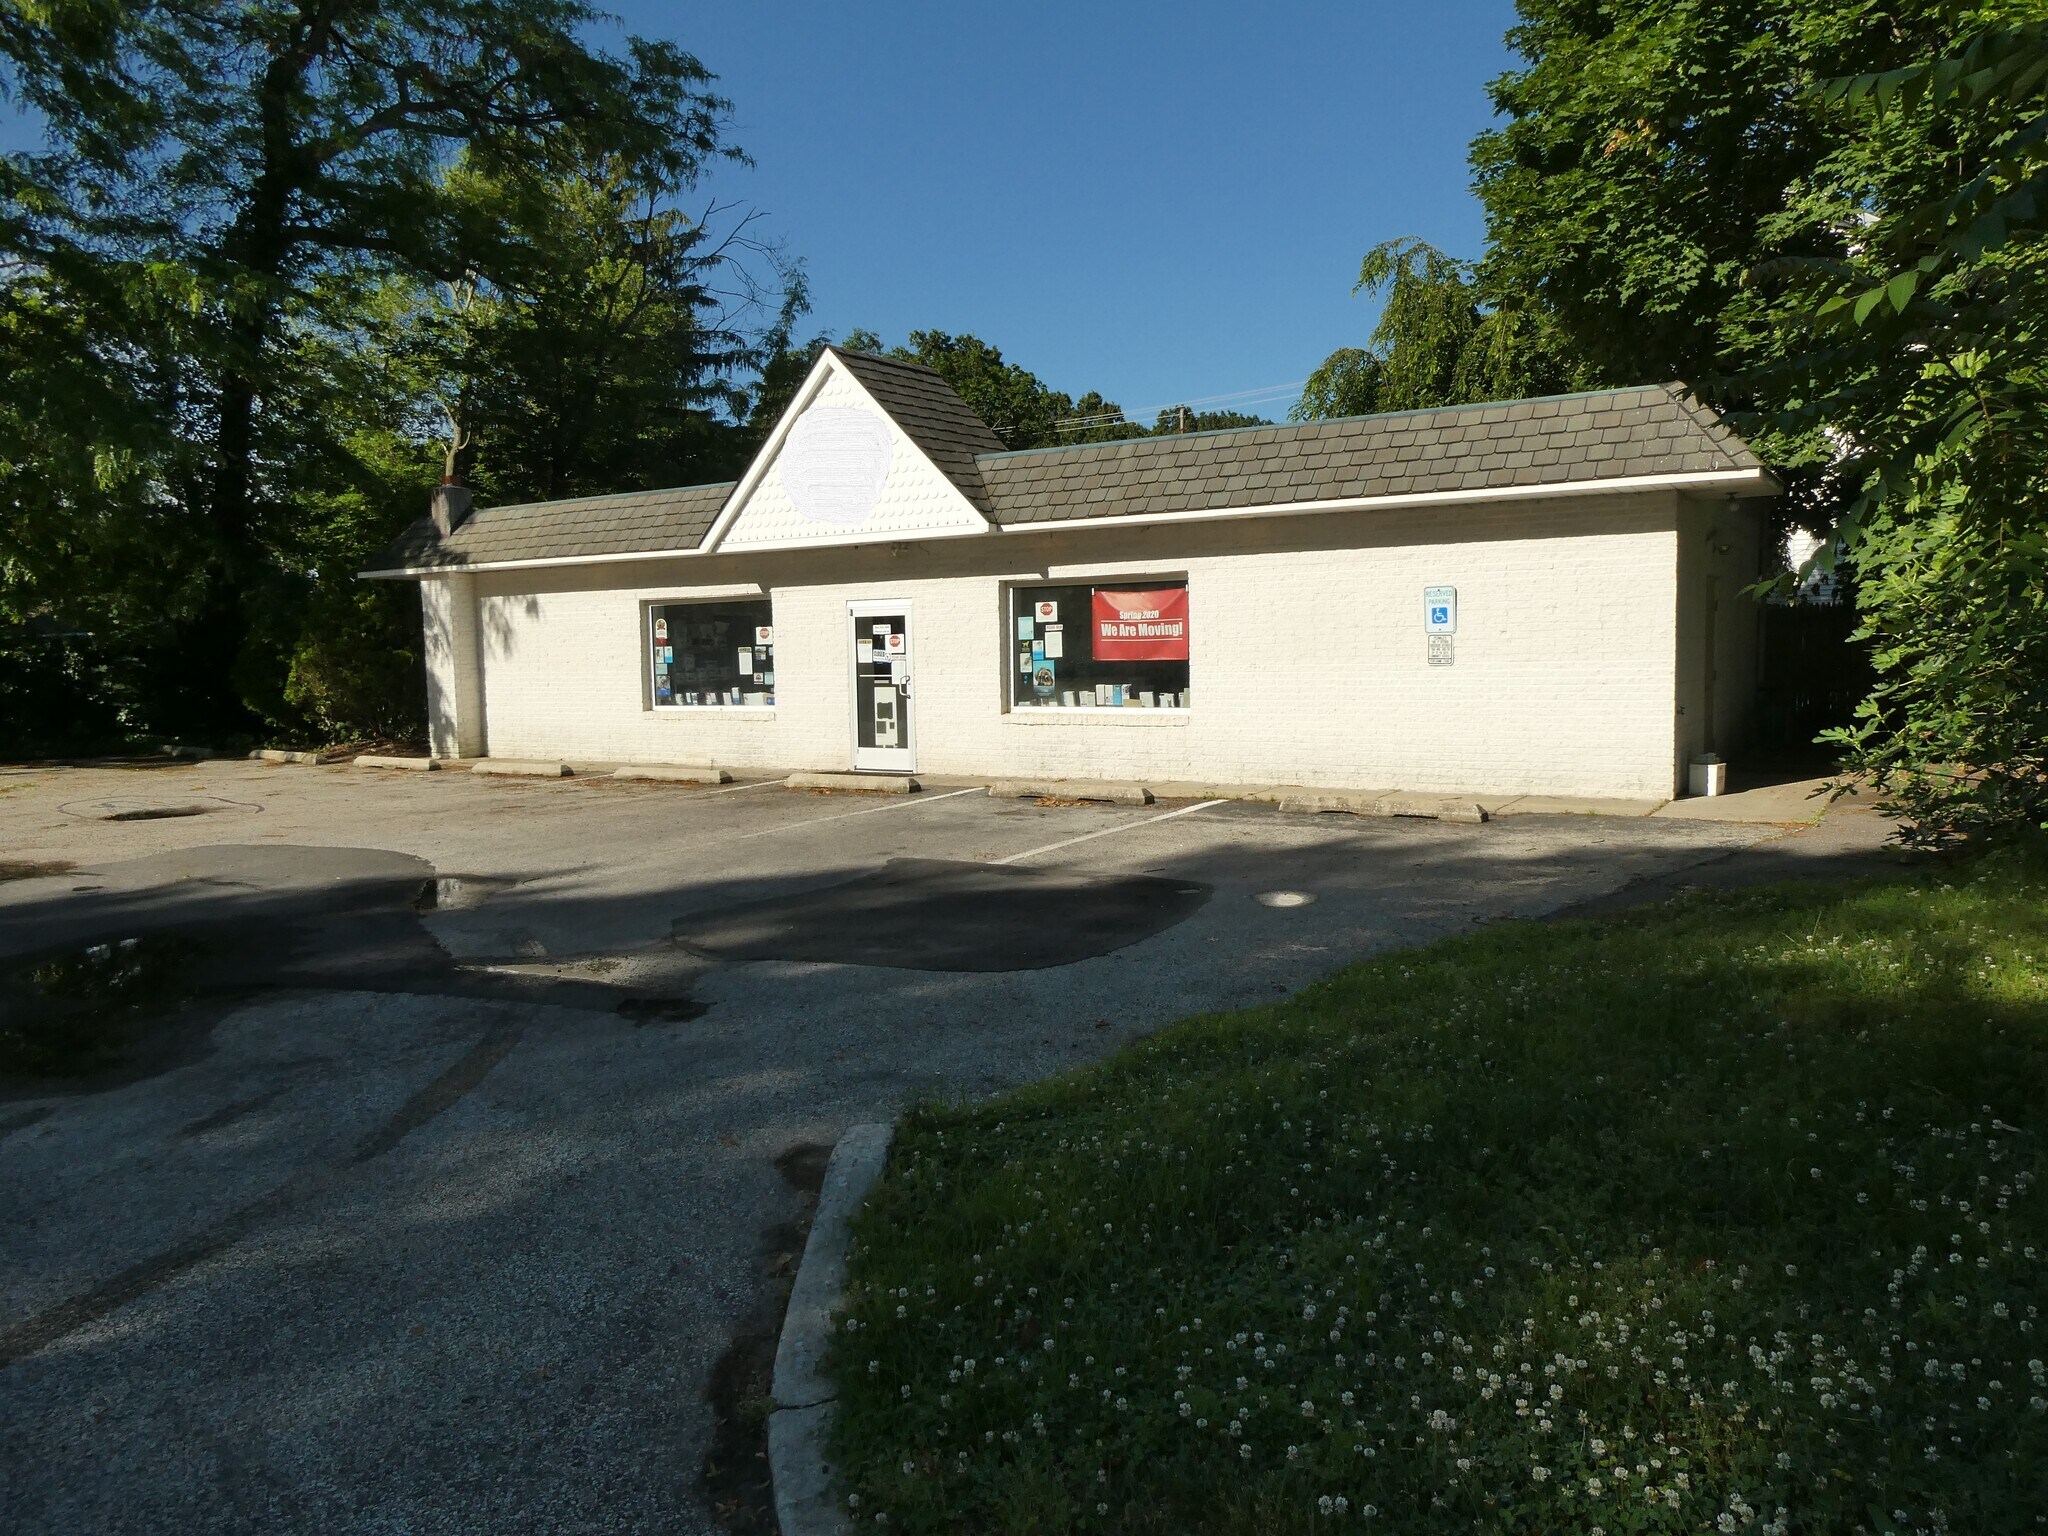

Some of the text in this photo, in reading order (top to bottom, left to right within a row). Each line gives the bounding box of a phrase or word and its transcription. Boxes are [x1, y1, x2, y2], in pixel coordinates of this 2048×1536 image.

[1426, 590, 1452, 598] RESERVED
[1119, 610, 1159, 620] Spring 2020
[1101, 622, 1183, 637] We Are Moving!
